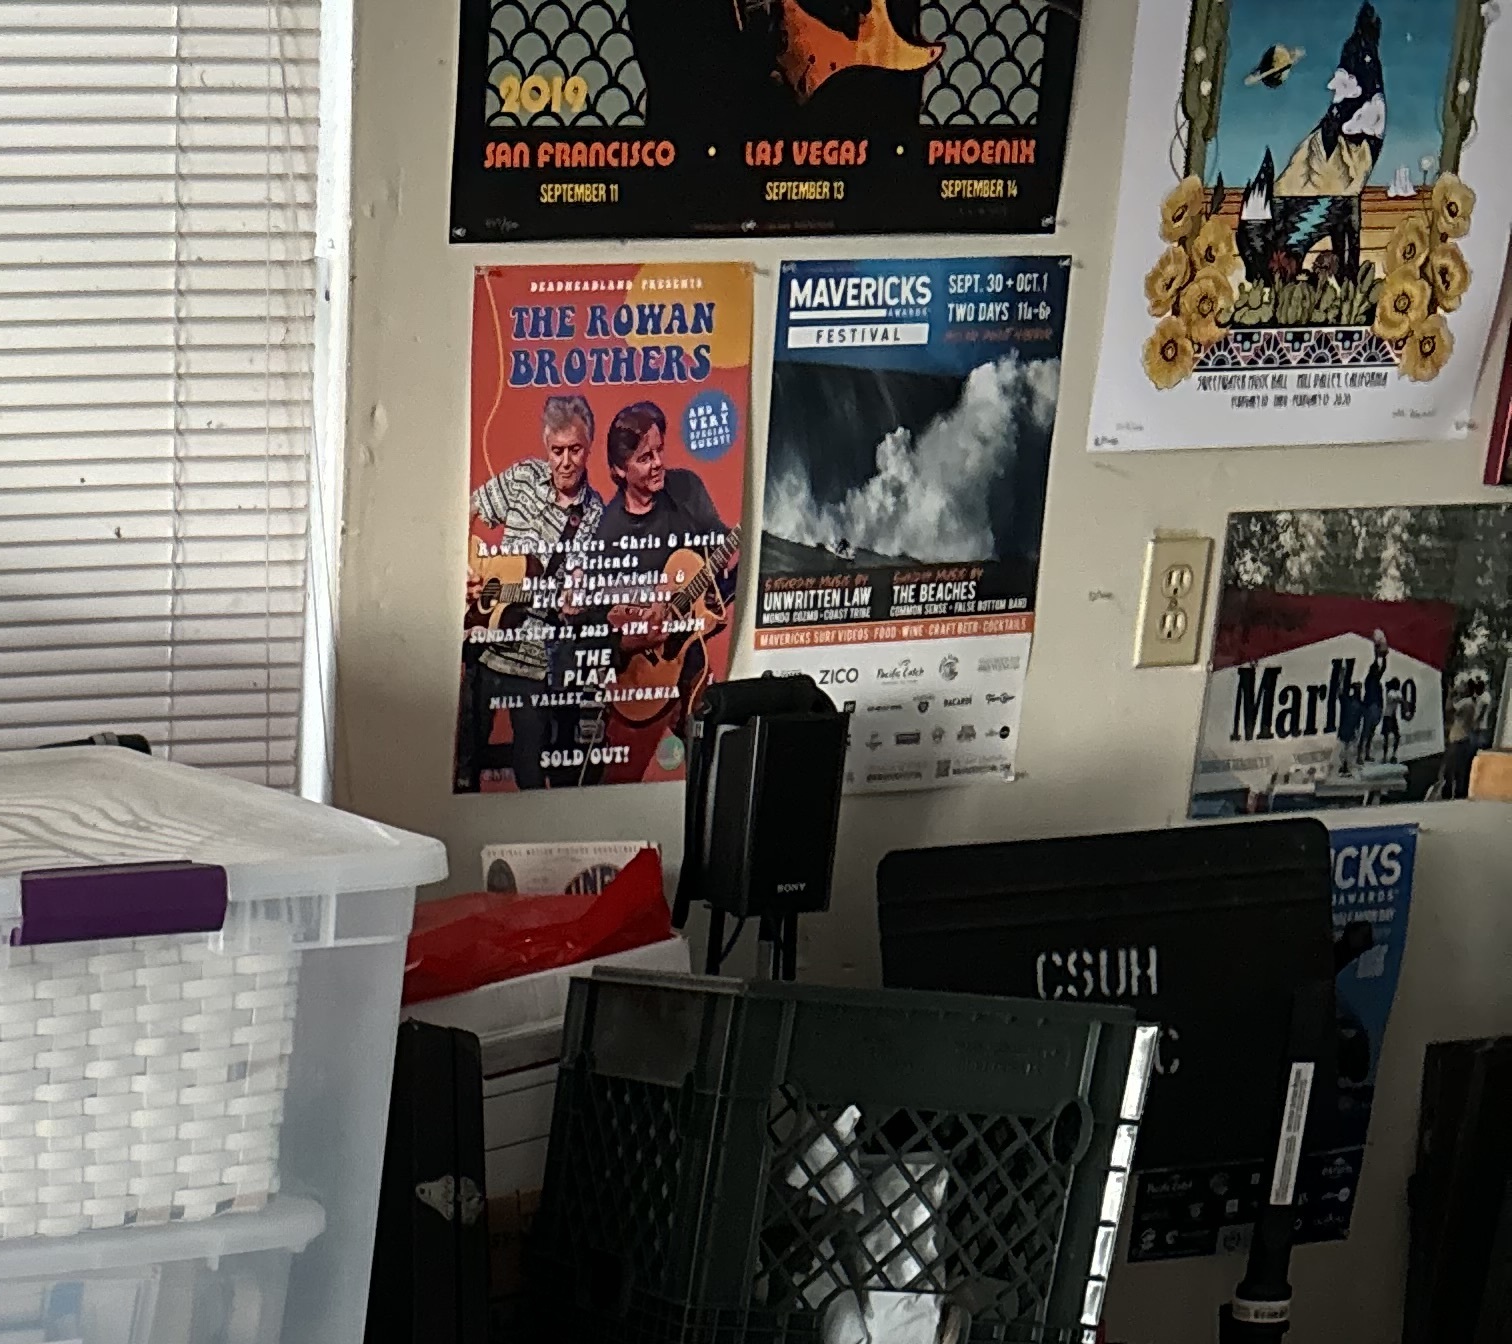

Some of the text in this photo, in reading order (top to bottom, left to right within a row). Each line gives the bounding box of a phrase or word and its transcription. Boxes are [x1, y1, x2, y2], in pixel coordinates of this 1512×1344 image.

[499, 75, 588, 113] 2019
[484, 140, 675, 168] SAN FRANCISCO
[745, 138, 868, 166] LAS VEGAS
[928, 138, 1036, 166] PHOENIX
[540, 182, 619, 203] SEPTEMBER 11
[765, 181, 844, 201] SEPTEMBER 13
[940, 178, 1018, 199] SEPTEMBER 14
[789, 275, 933, 309] MAVERICKS
[948, 273, 984, 294] SEPT.
[986, 273, 1003, 293] 30
[510, 302, 716, 340] THE ROWAN
[948, 302, 975, 323] TWO
[978, 301, 1010, 322] DAYS
[816, 327, 901, 344] FESTIVAL
[508, 344, 712, 388] BROTHERS
[537, 540, 606, 554] Brothers
[763, 586, 872, 611] UNWRITTEN LAW
[893, 581, 977, 605] THE BEACHES
[760, 631, 811, 646] MAVERICKS
[813, 629, 836, 643] SURF
[837, 628, 869, 642] VIDEOS
[874, 626, 897, 640] FOOD
[928, 622, 956, 637] CRAFT
[574, 648, 613, 668] THE
[818, 667, 859, 684] ZICO
[489, 695, 524, 709] MILL
[594, 686, 681, 703] CALIFORNIA
[1230, 658, 1416, 742] Marlbro
[540, 745, 630, 768] SOLD OUT!
[1036, 945, 1158, 1000] CSUH
